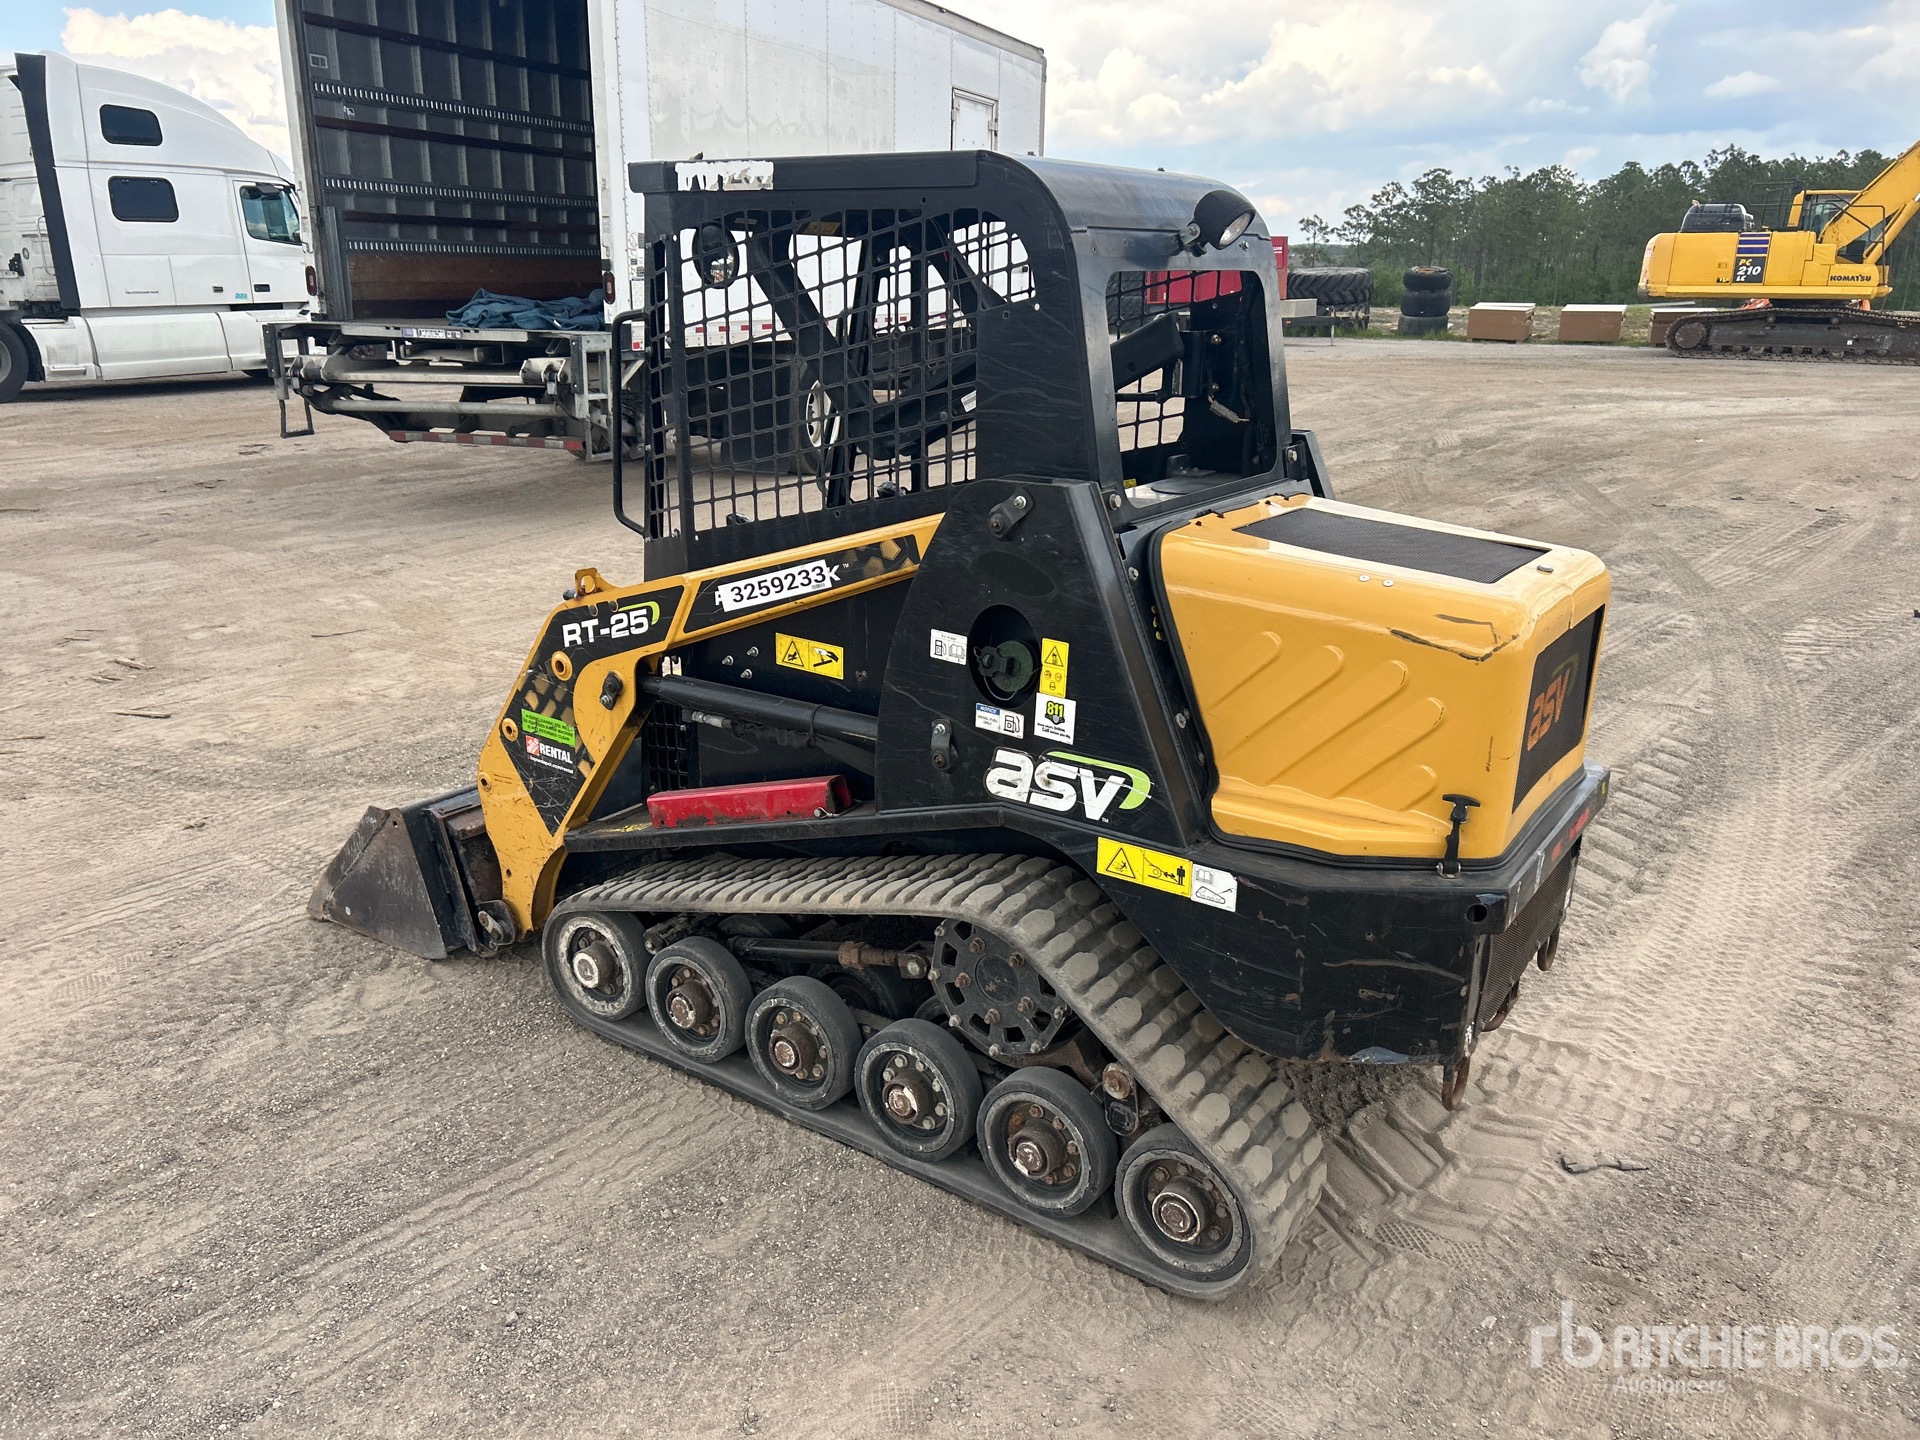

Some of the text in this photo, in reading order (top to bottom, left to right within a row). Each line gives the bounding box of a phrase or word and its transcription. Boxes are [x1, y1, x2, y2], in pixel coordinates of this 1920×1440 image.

[1736, 266, 1762, 275] 210
[1830, 274, 1872, 282] KOMATSU
[730, 566, 826, 603] 3259233
[562, 608, 649, 648] RT-25
[979, 706, 998, 715] NOTICE
[1046, 700, 1064, 718] 811
[540, 742, 573, 765] RENTAL
